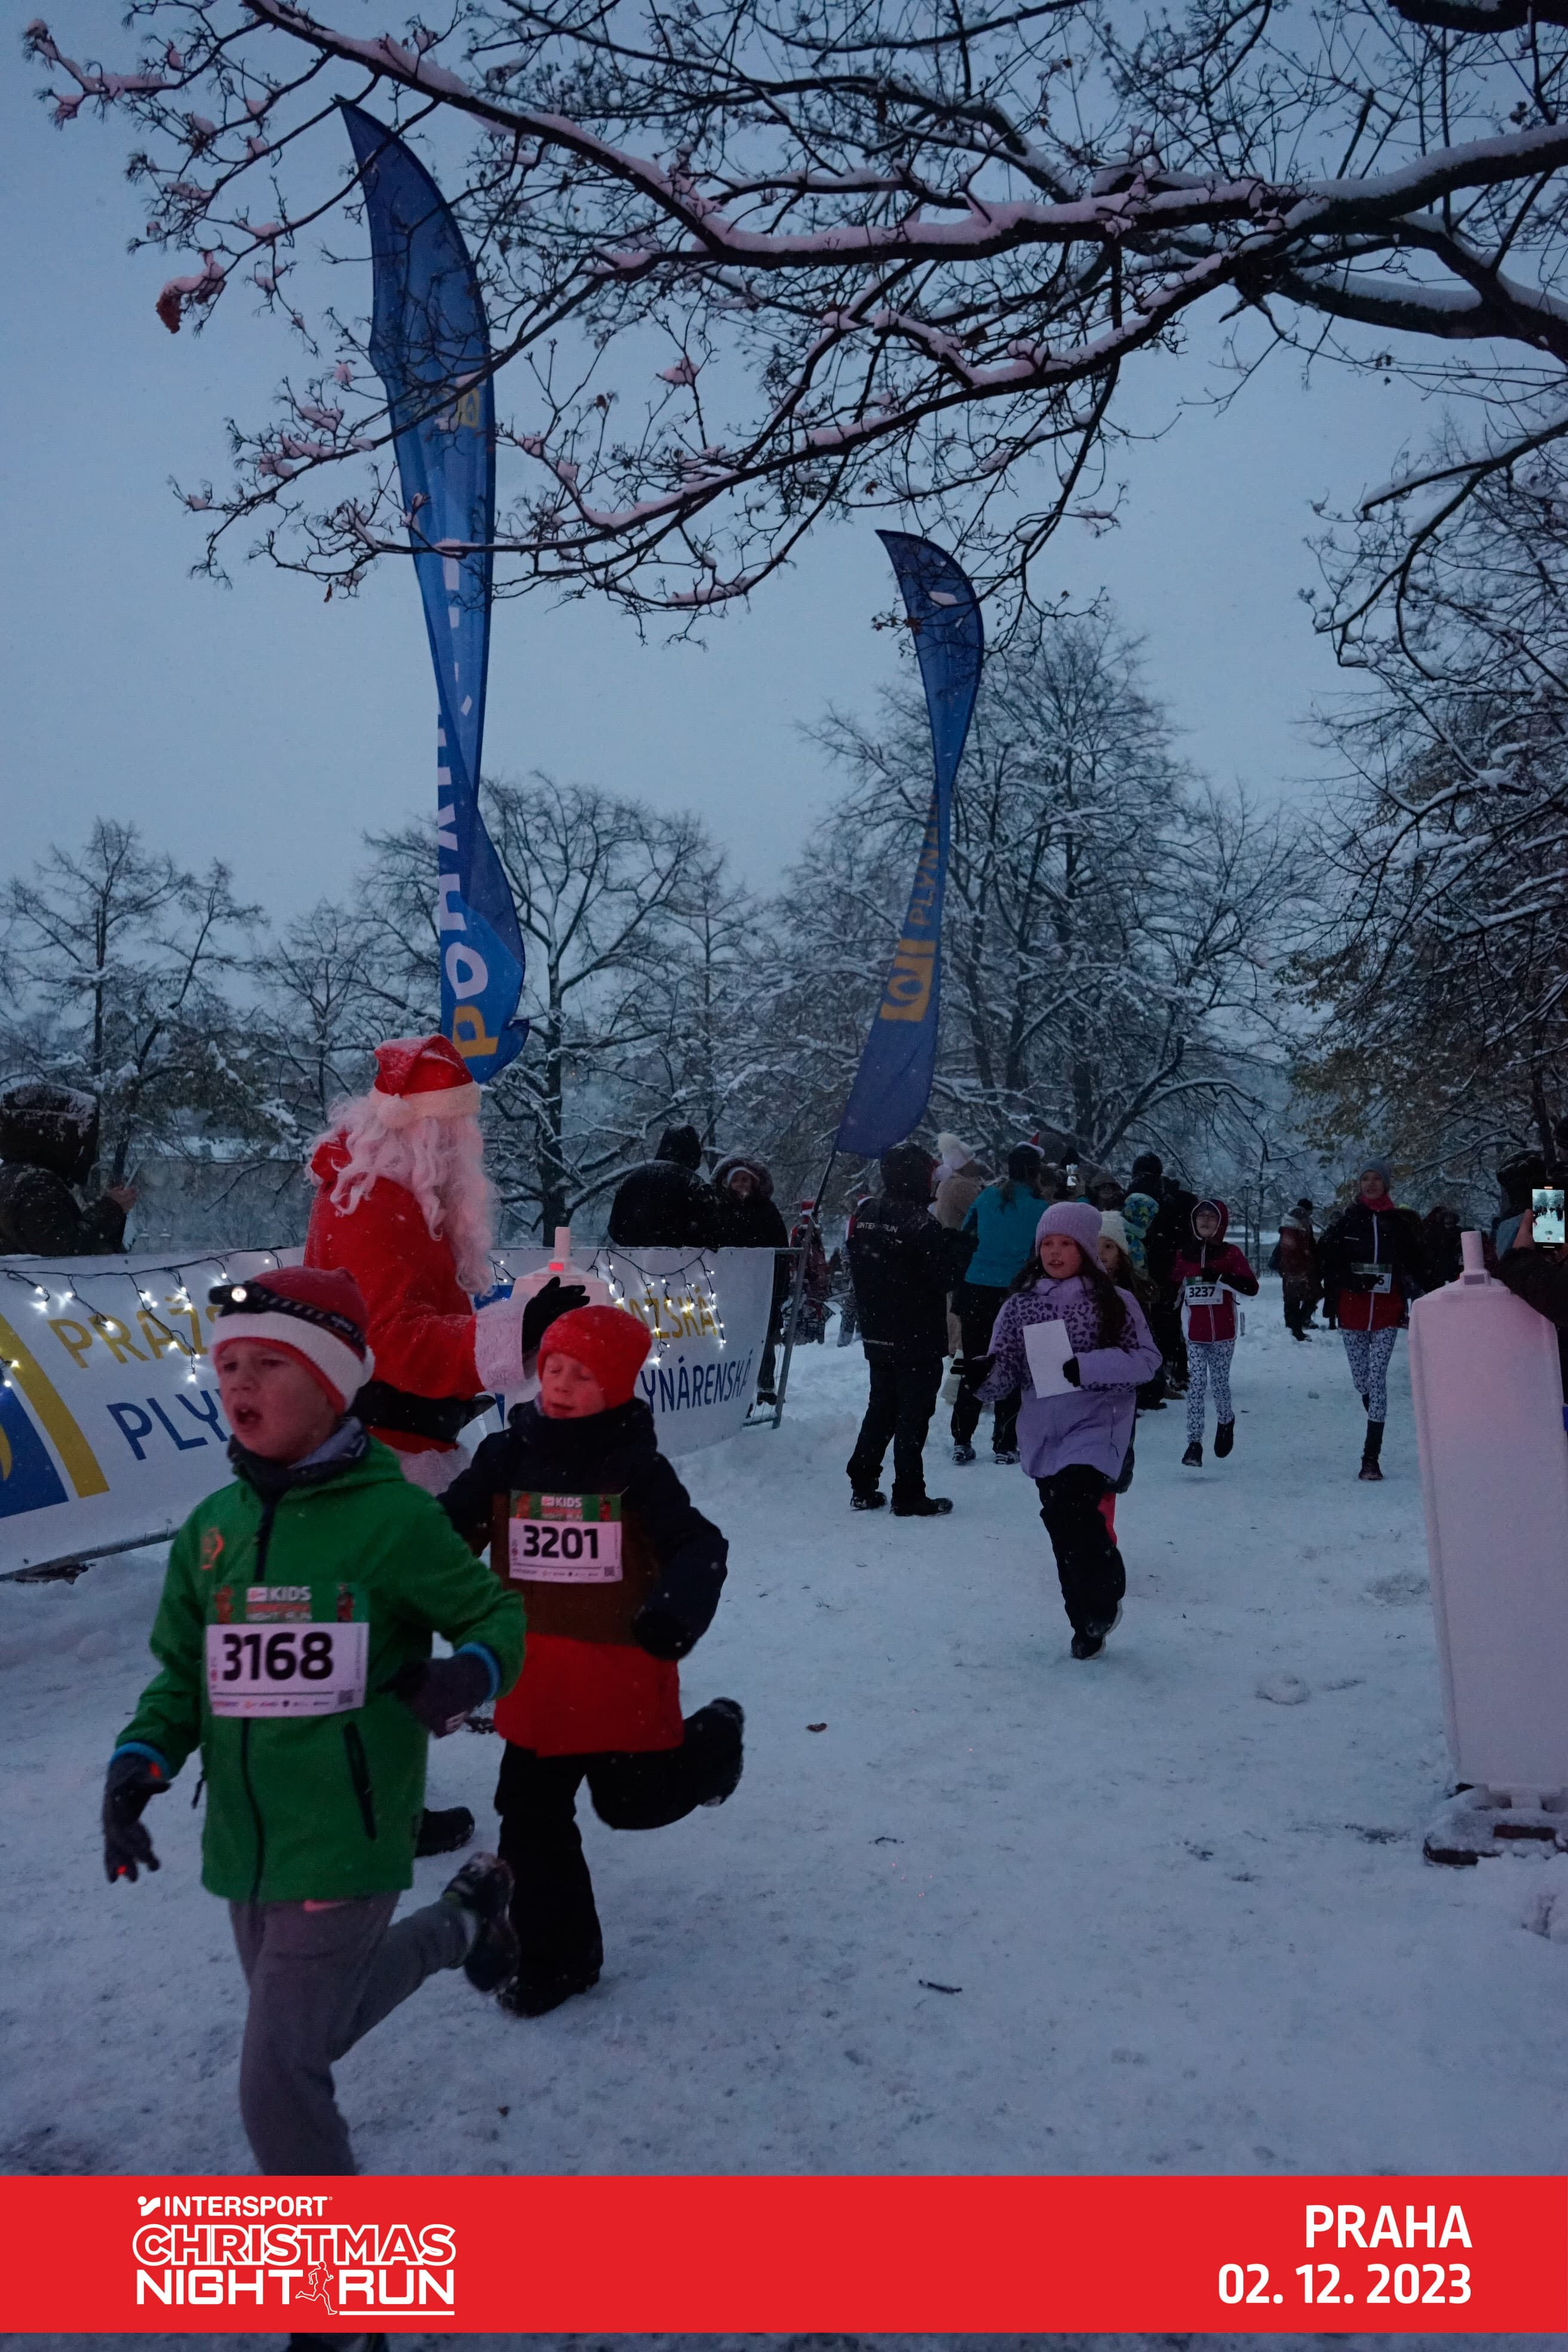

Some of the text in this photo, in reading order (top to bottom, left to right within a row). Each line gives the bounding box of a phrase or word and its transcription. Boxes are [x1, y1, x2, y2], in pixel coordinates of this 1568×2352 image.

[1189, 1286, 1215, 1297] 3237
[639, 1348, 754, 1414] YNÁRENSKÁ
[106, 1388, 228, 1461] PLY
[555, 1496, 583, 1508] KIDS
[523, 1525, 598, 1559] 3201
[269, 1586, 313, 1601] KIDS
[222, 1632, 333, 1681] 3168
